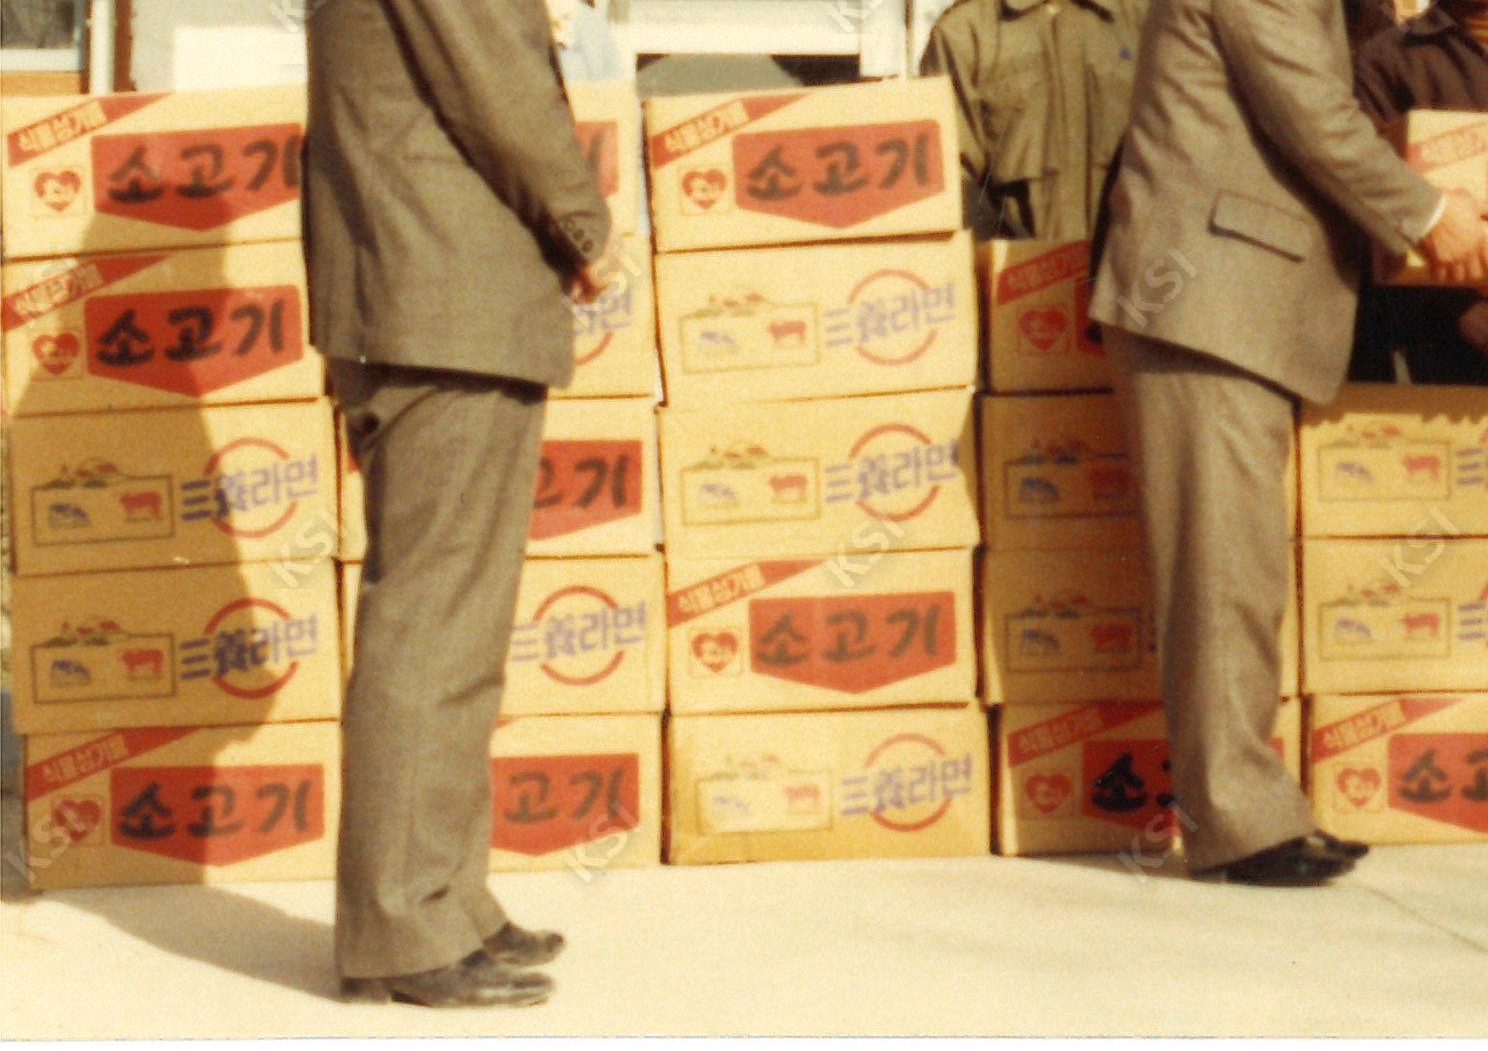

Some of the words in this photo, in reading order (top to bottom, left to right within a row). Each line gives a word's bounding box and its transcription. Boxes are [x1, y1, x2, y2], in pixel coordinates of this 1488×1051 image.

[107, 134, 301, 203] 소고기
[746, 132, 929, 201] 소고기
[95, 300, 284, 366] 소고기
[755, 604, 940, 668] 소고기
[118, 778, 312, 840] 소고기
[503, 767, 624, 823] 고기
